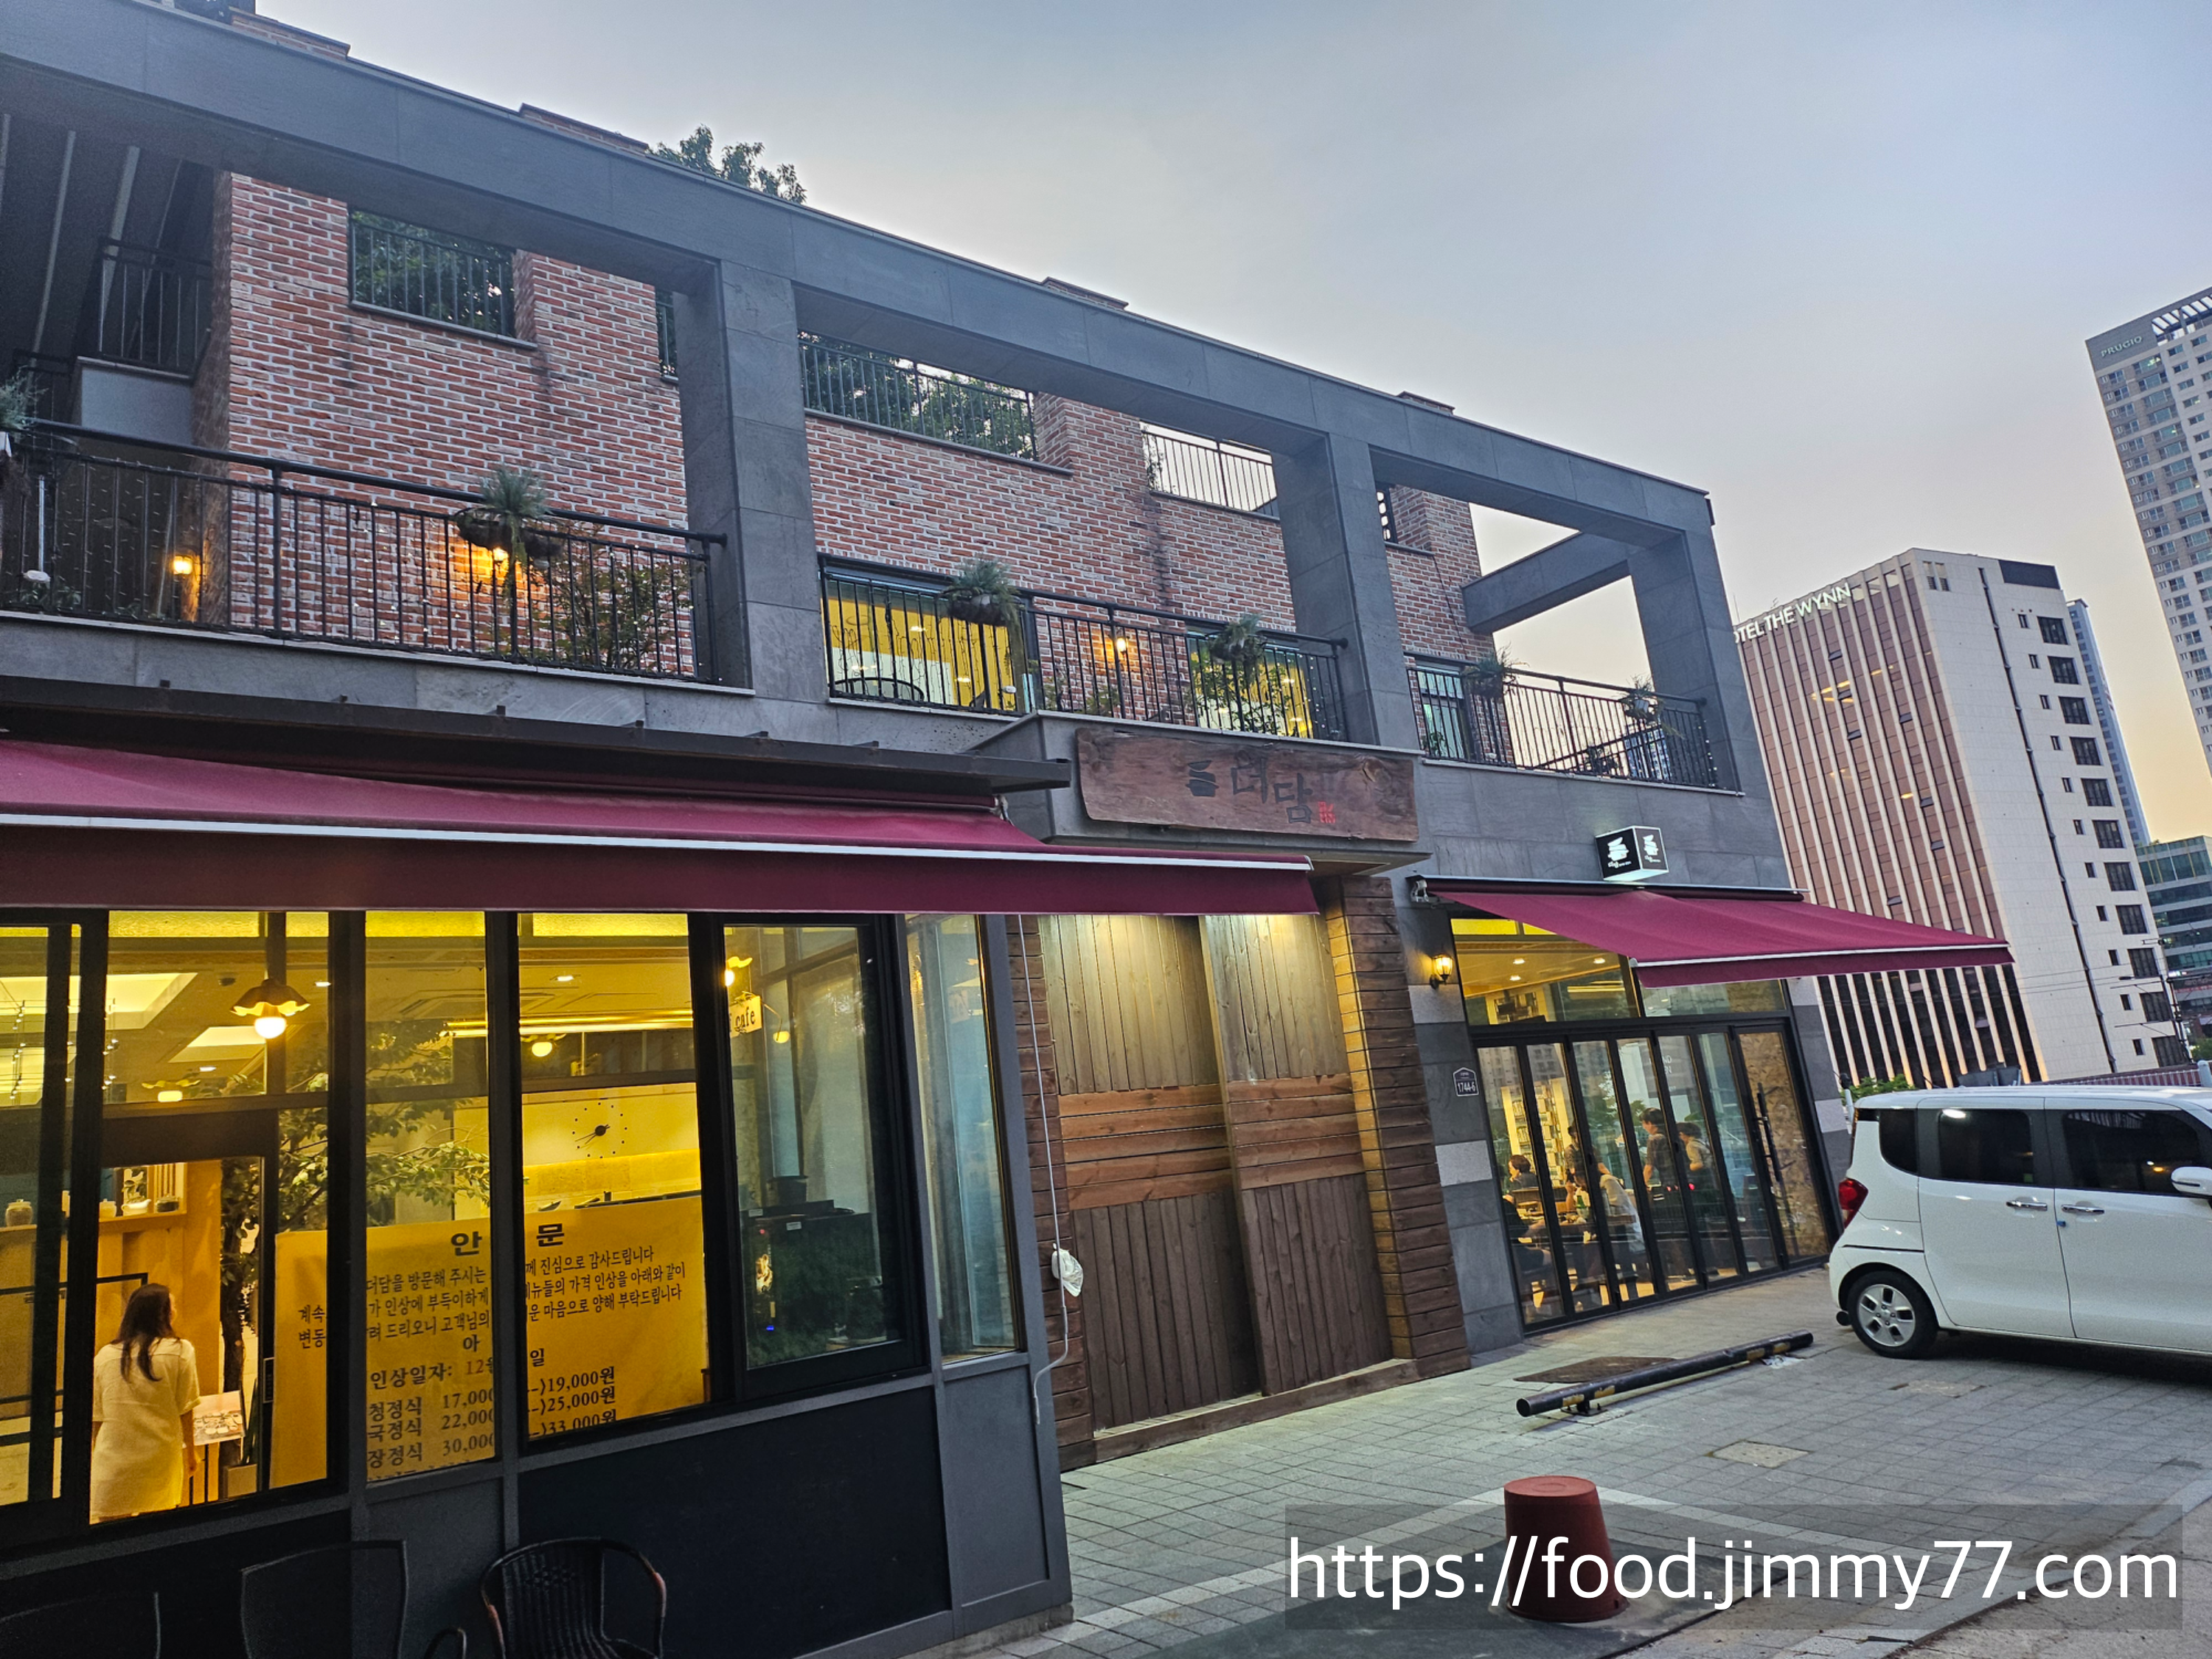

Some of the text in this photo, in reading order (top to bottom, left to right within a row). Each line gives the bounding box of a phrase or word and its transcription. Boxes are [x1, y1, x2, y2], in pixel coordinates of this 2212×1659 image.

[2101, 335, 2142, 357] PRUGIO
[1764, 605, 1795, 631] THE
[1795, 582, 1851, 617] WYNN
[734, 1006, 756, 1028] cafe
[408, 1268, 445, 1290] 방문해
[450, 1265, 486, 1287] 주시는
[540, 1256, 585, 1276] 진심으로
[589, 1245, 654, 1270] 감사드립니다
[298, 1304, 326, 1324] 계속
[385, 1295, 423, 1317] 인상에
[428, 1287, 490, 1312] 부득이하게
[568, 1274, 591, 1293] 가격
[594, 1270, 628, 1290] 인상을
[630, 1265, 664, 1285] 아래와
[666, 1262, 685, 1281] 같이
[385, 1316, 437, 1338] 드리오니
[440, 1310, 490, 1332] 고객님의
[544, 1299, 589, 1319] 마음으로
[592, 1293, 614, 1312] 양해
[618, 1284, 683, 1309] 부탁드립니다
[370, 1363, 453, 1390] 인상일자:
[529, 1348, 545, 1367] 일
